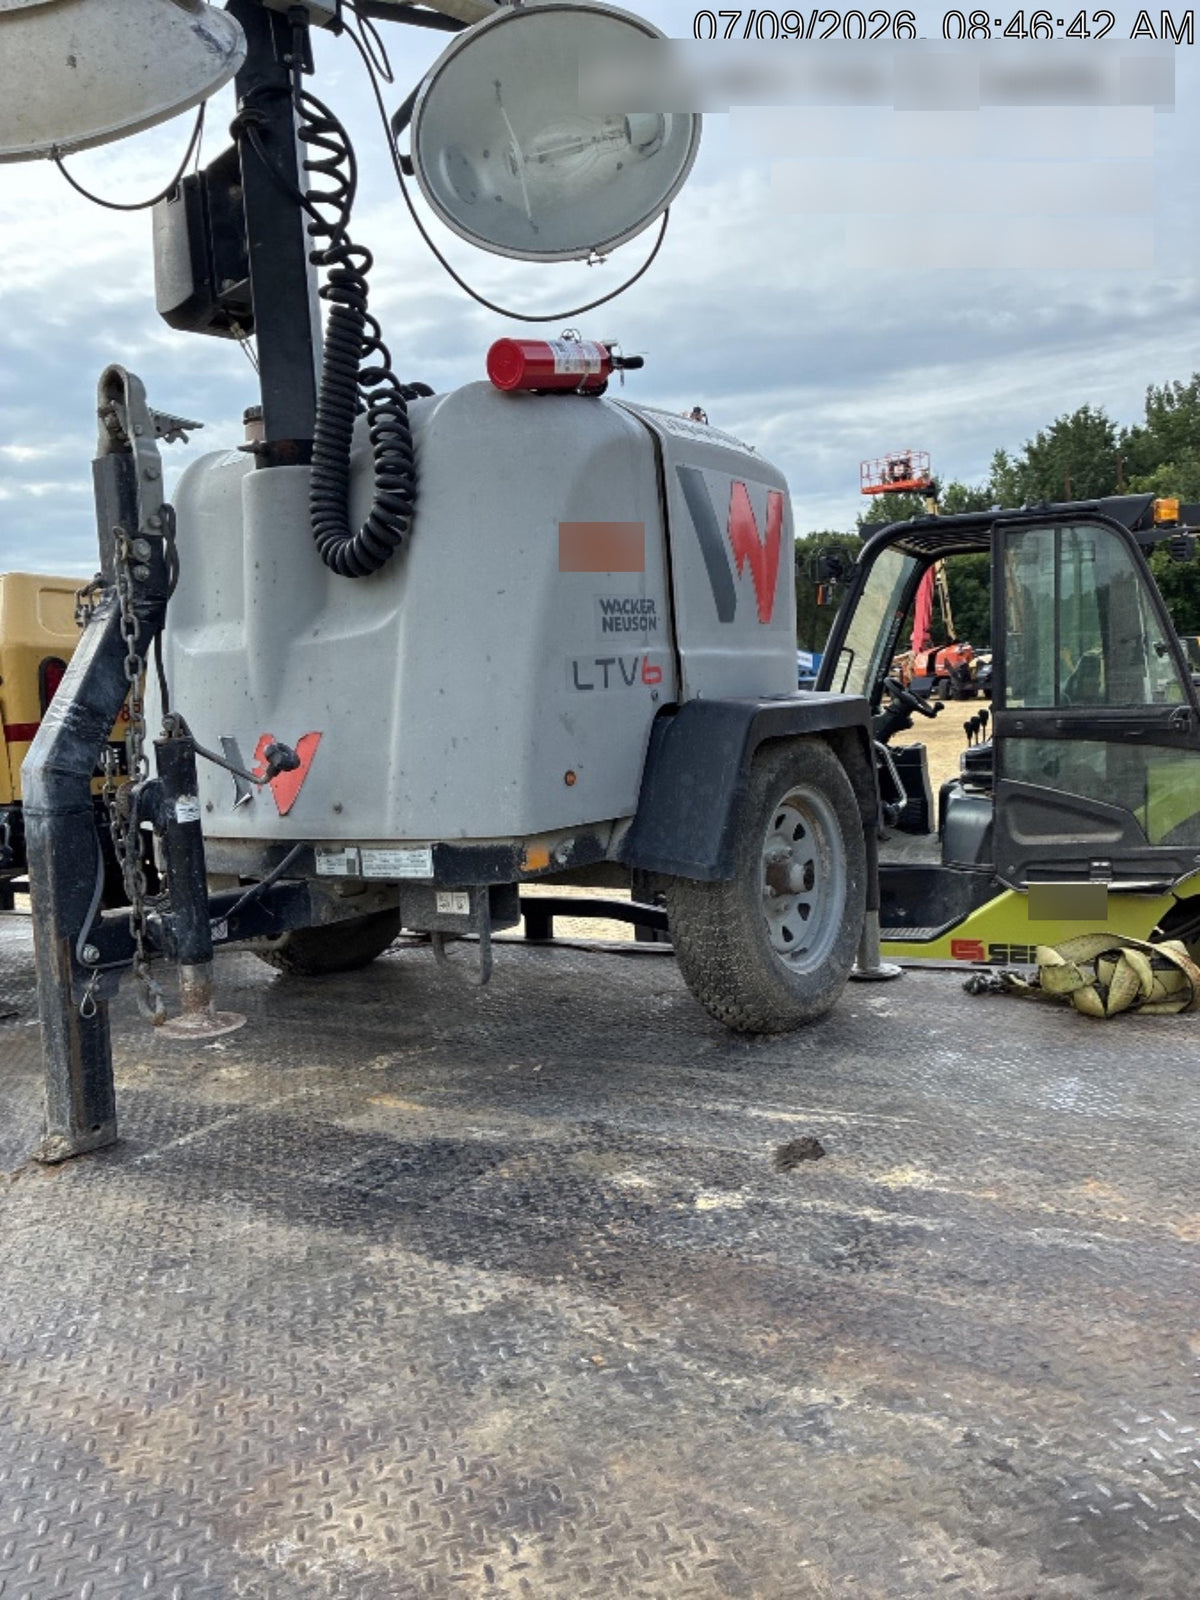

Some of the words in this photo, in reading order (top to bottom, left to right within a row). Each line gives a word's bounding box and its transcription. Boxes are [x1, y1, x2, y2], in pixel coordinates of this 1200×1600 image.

[600, 599, 656, 615] WACKER
[602, 616, 657, 633] NEUSON
[572, 655, 663, 690] LTV6
